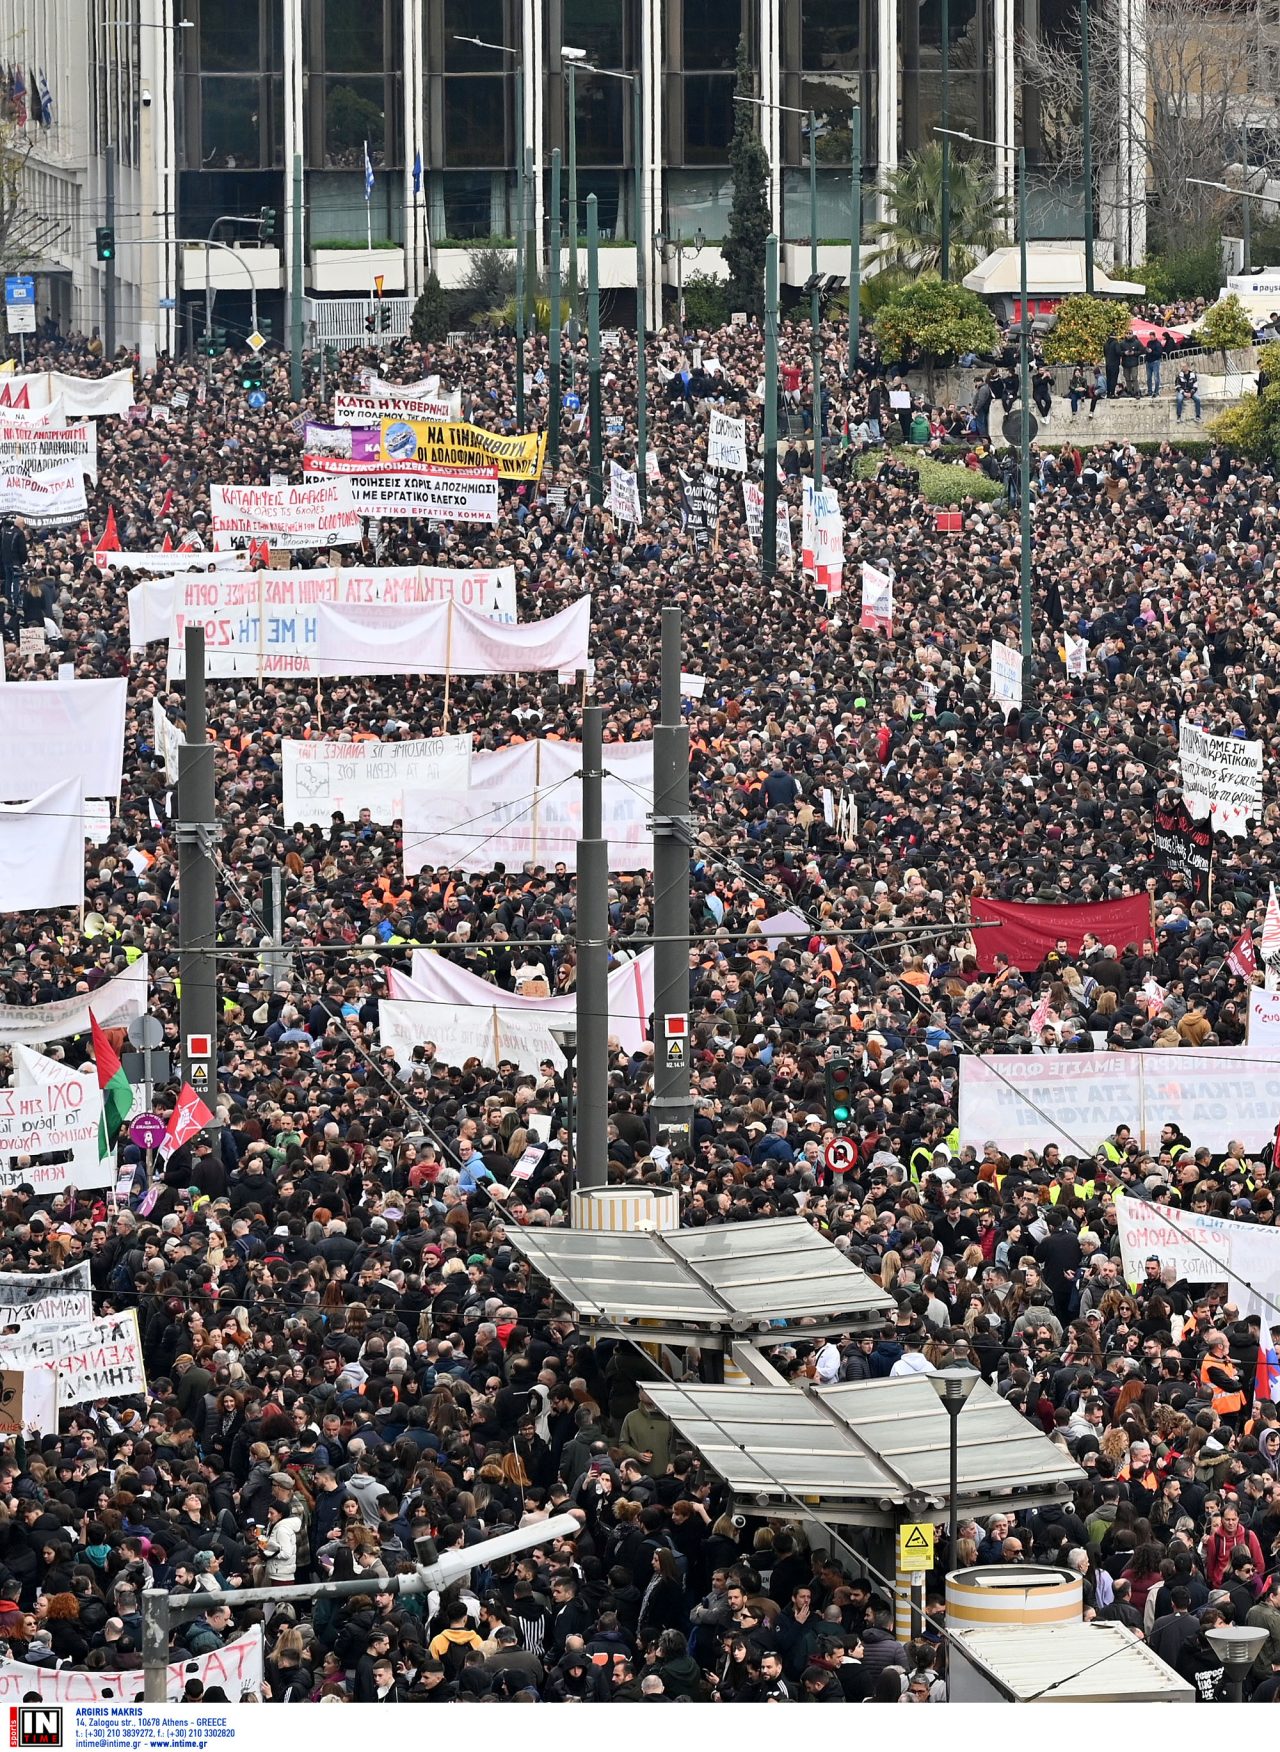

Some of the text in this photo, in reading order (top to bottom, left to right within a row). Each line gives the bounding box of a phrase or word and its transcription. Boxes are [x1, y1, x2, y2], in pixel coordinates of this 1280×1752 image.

[338, 396, 389, 410] ΚΑΤΩ Η
[338, 410, 355, 418] ΤΟΥ
[428, 426, 444, 444] ΝΑ
[418, 446, 428, 462] ΟΙ
[431, 447, 484, 467] ΔΟΛΟΦΟΝΟΙ
[404, 478, 431, 490] ΧΩΡΙΣ
[289, 486, 338, 505] ΔΙΑΡΚΕΙΑΣ
[362, 491, 467, 505] ΜΕ ΕΡΓΑΤΙΚΟ ΕΛΕΓΧΟ
[411, 507, 492, 520] ΕΡΓΑΤΙΚΟ ΚΟΜΜΑ
[1209, 738, 1246, 755] ΑΜΕΣΗ
